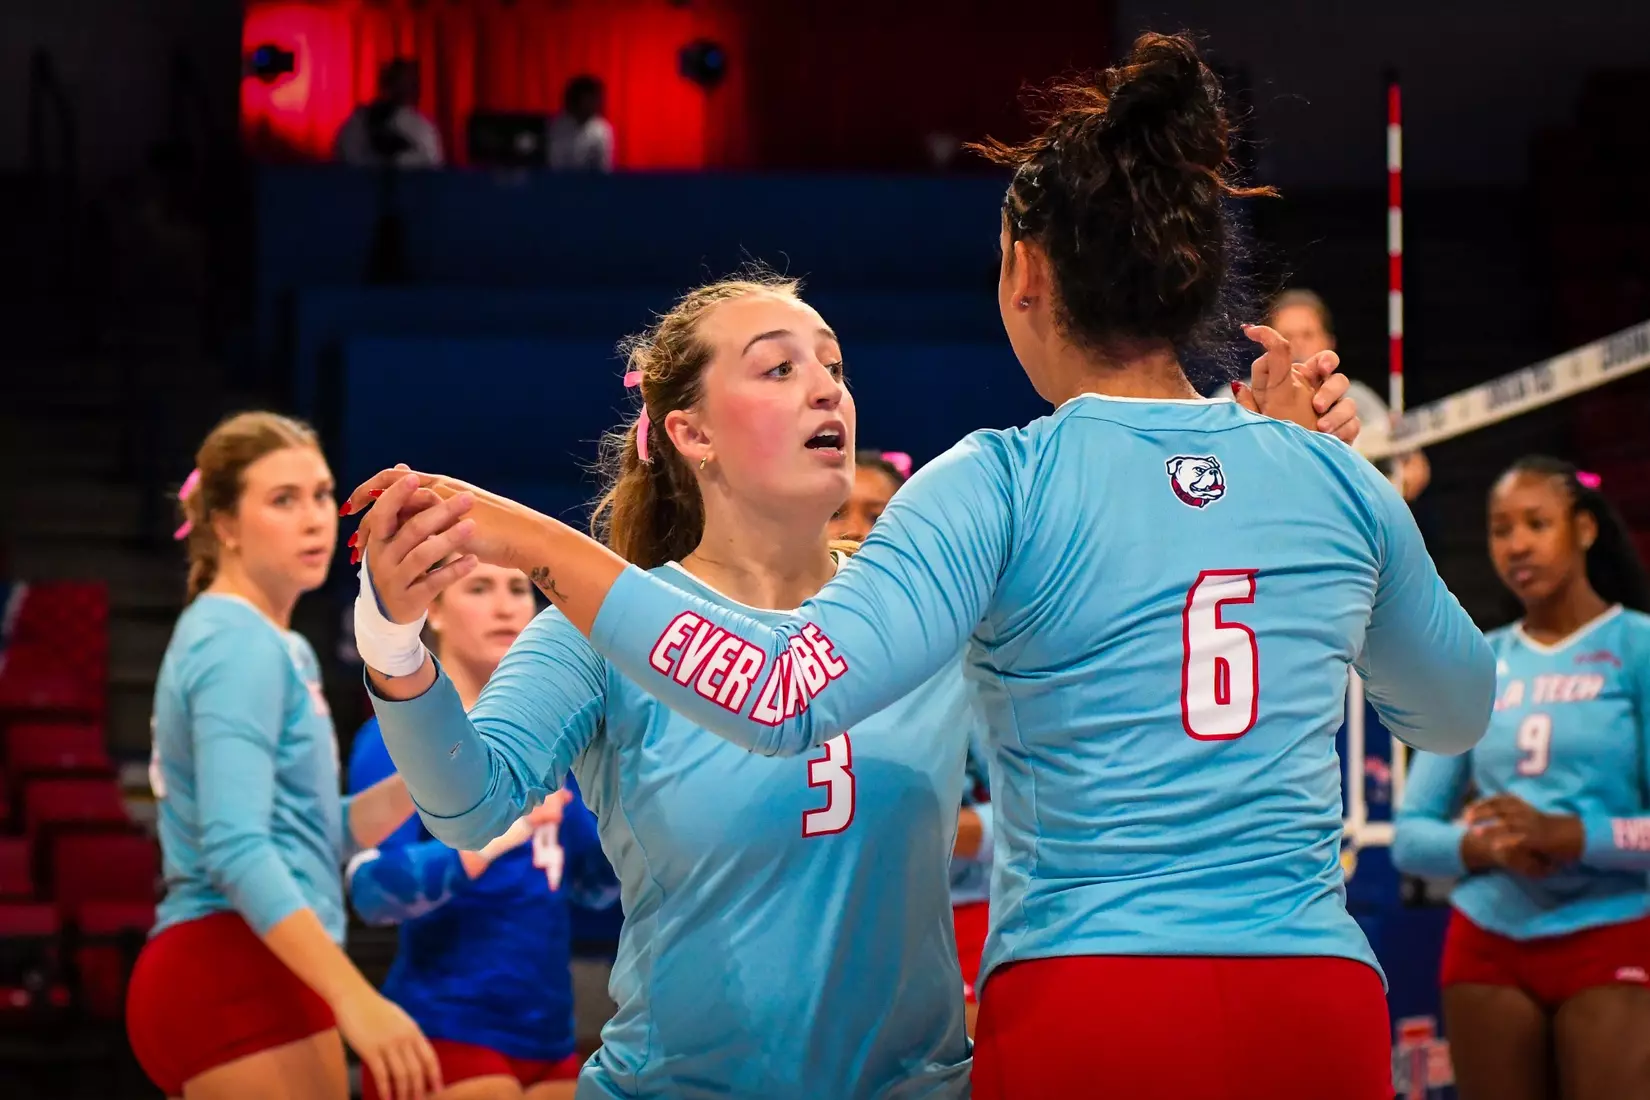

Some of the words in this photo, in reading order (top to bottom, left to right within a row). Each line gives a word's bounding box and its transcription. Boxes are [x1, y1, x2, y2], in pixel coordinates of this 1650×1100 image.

[649, 610, 766, 714] EVER
[1181, 569, 1259, 741] 6
[803, 732, 855, 838] 3
[1516, 712, 1551, 777] 9
